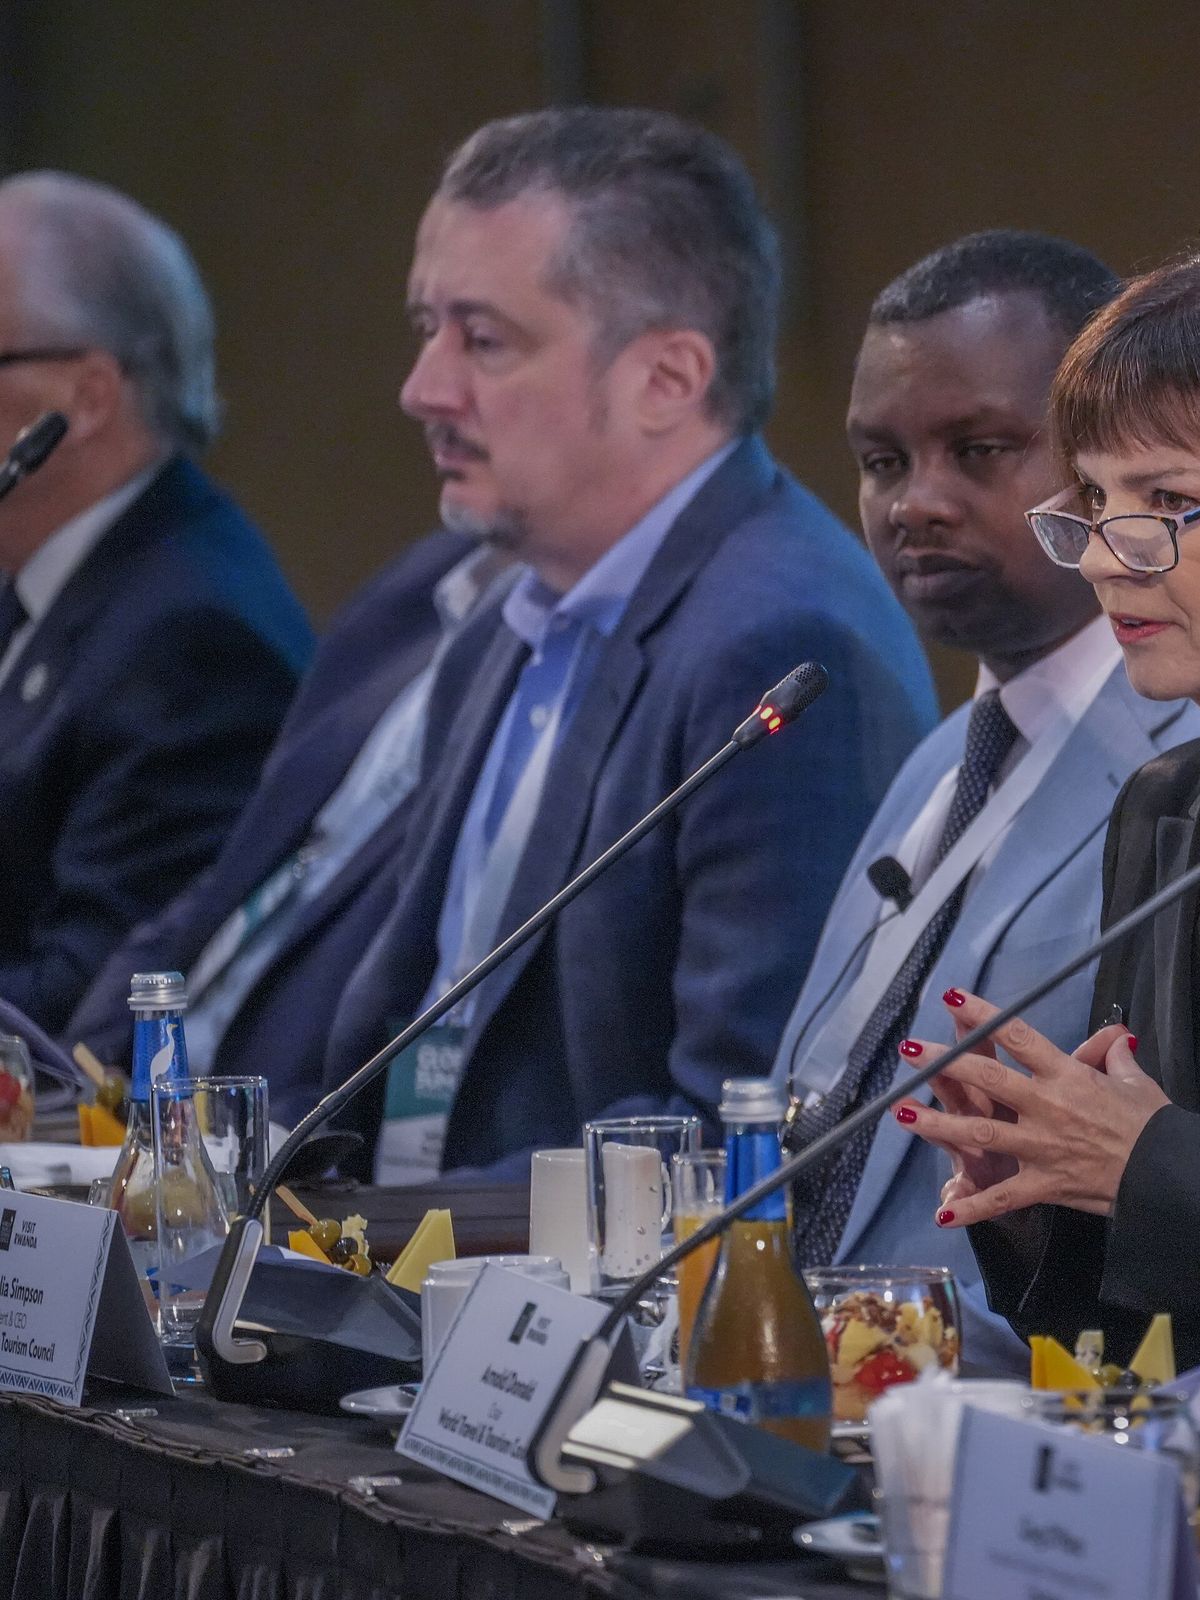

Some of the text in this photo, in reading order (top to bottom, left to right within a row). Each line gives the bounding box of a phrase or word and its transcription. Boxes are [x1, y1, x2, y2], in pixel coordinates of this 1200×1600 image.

[22, 1220, 37, 1234] VISIT
[14, 1233, 38, 1249] RWANDA
[10, 1277, 44, 1307] Simpson
[14, 1312, 27, 1329] CEO
[1, 1332, 56, 1363] Tourism Council
